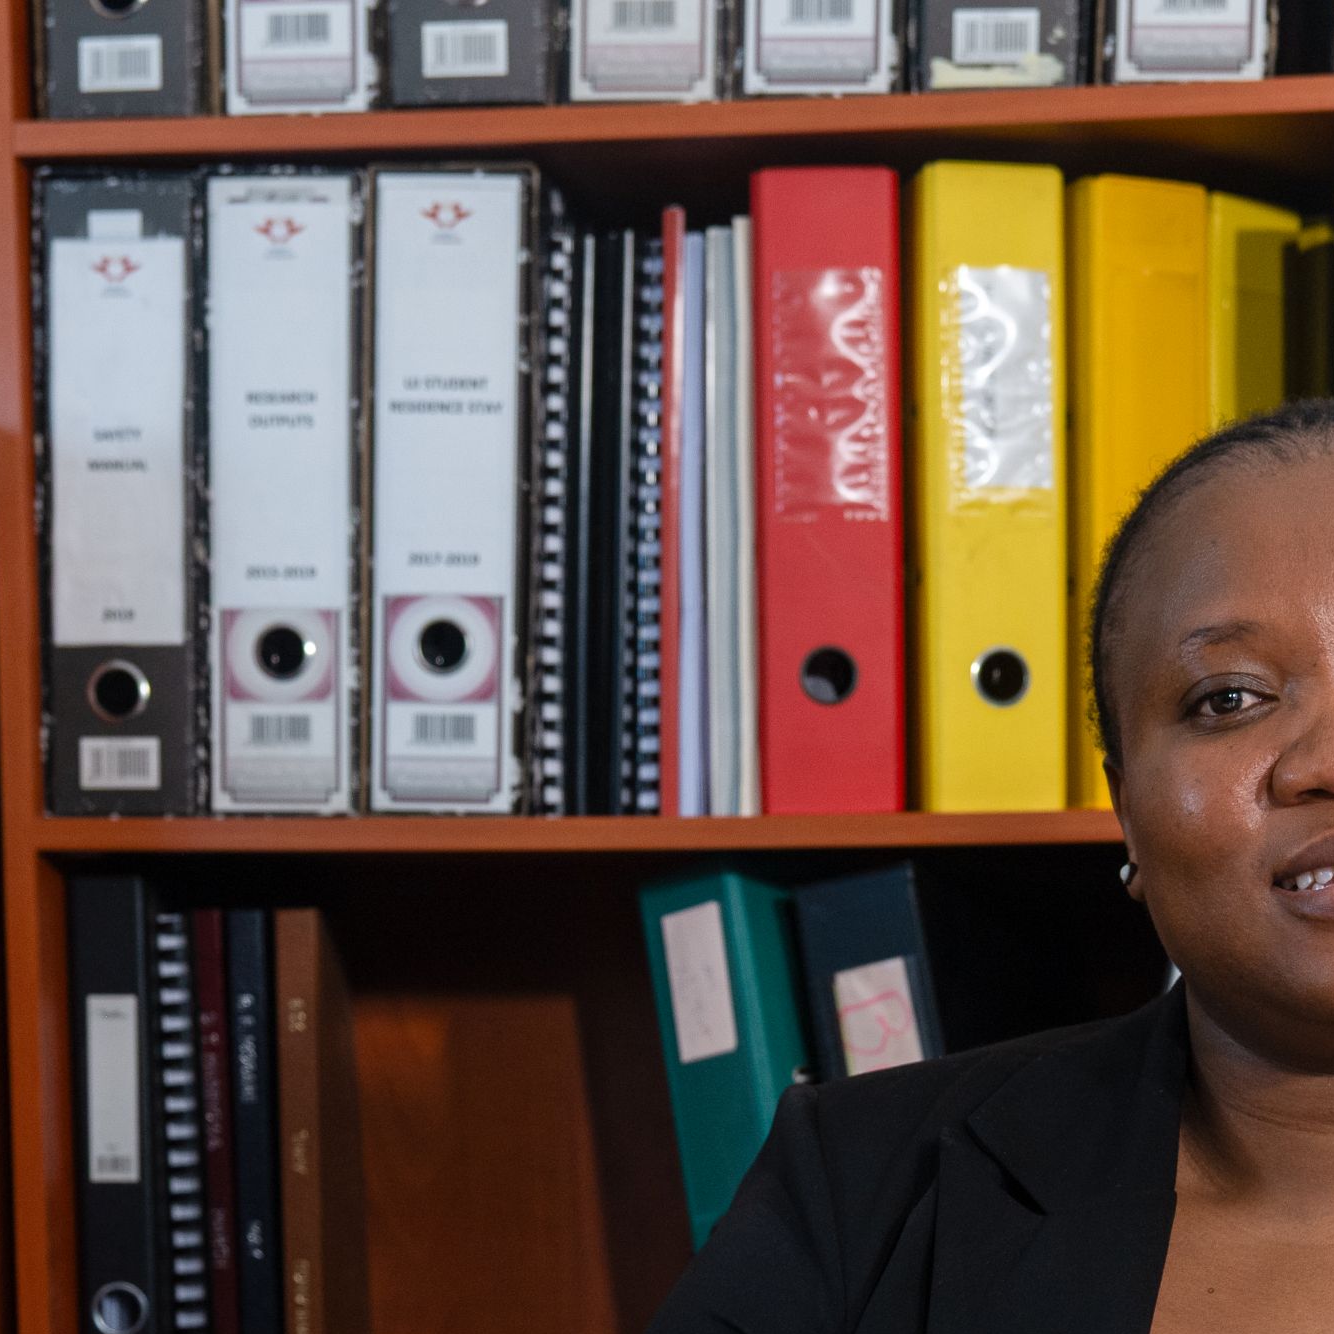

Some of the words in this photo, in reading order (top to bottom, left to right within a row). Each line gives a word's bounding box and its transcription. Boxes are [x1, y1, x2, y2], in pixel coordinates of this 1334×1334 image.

[424, 376, 489, 391] STUDENT
[245, 391, 317, 405] RESEARCH
[388, 399, 464, 414] RESIDENCE
[468, 398, 504, 413] STAY
[248, 413, 315, 428] OUTPUTS
[86, 459, 148, 473] MANUAL
